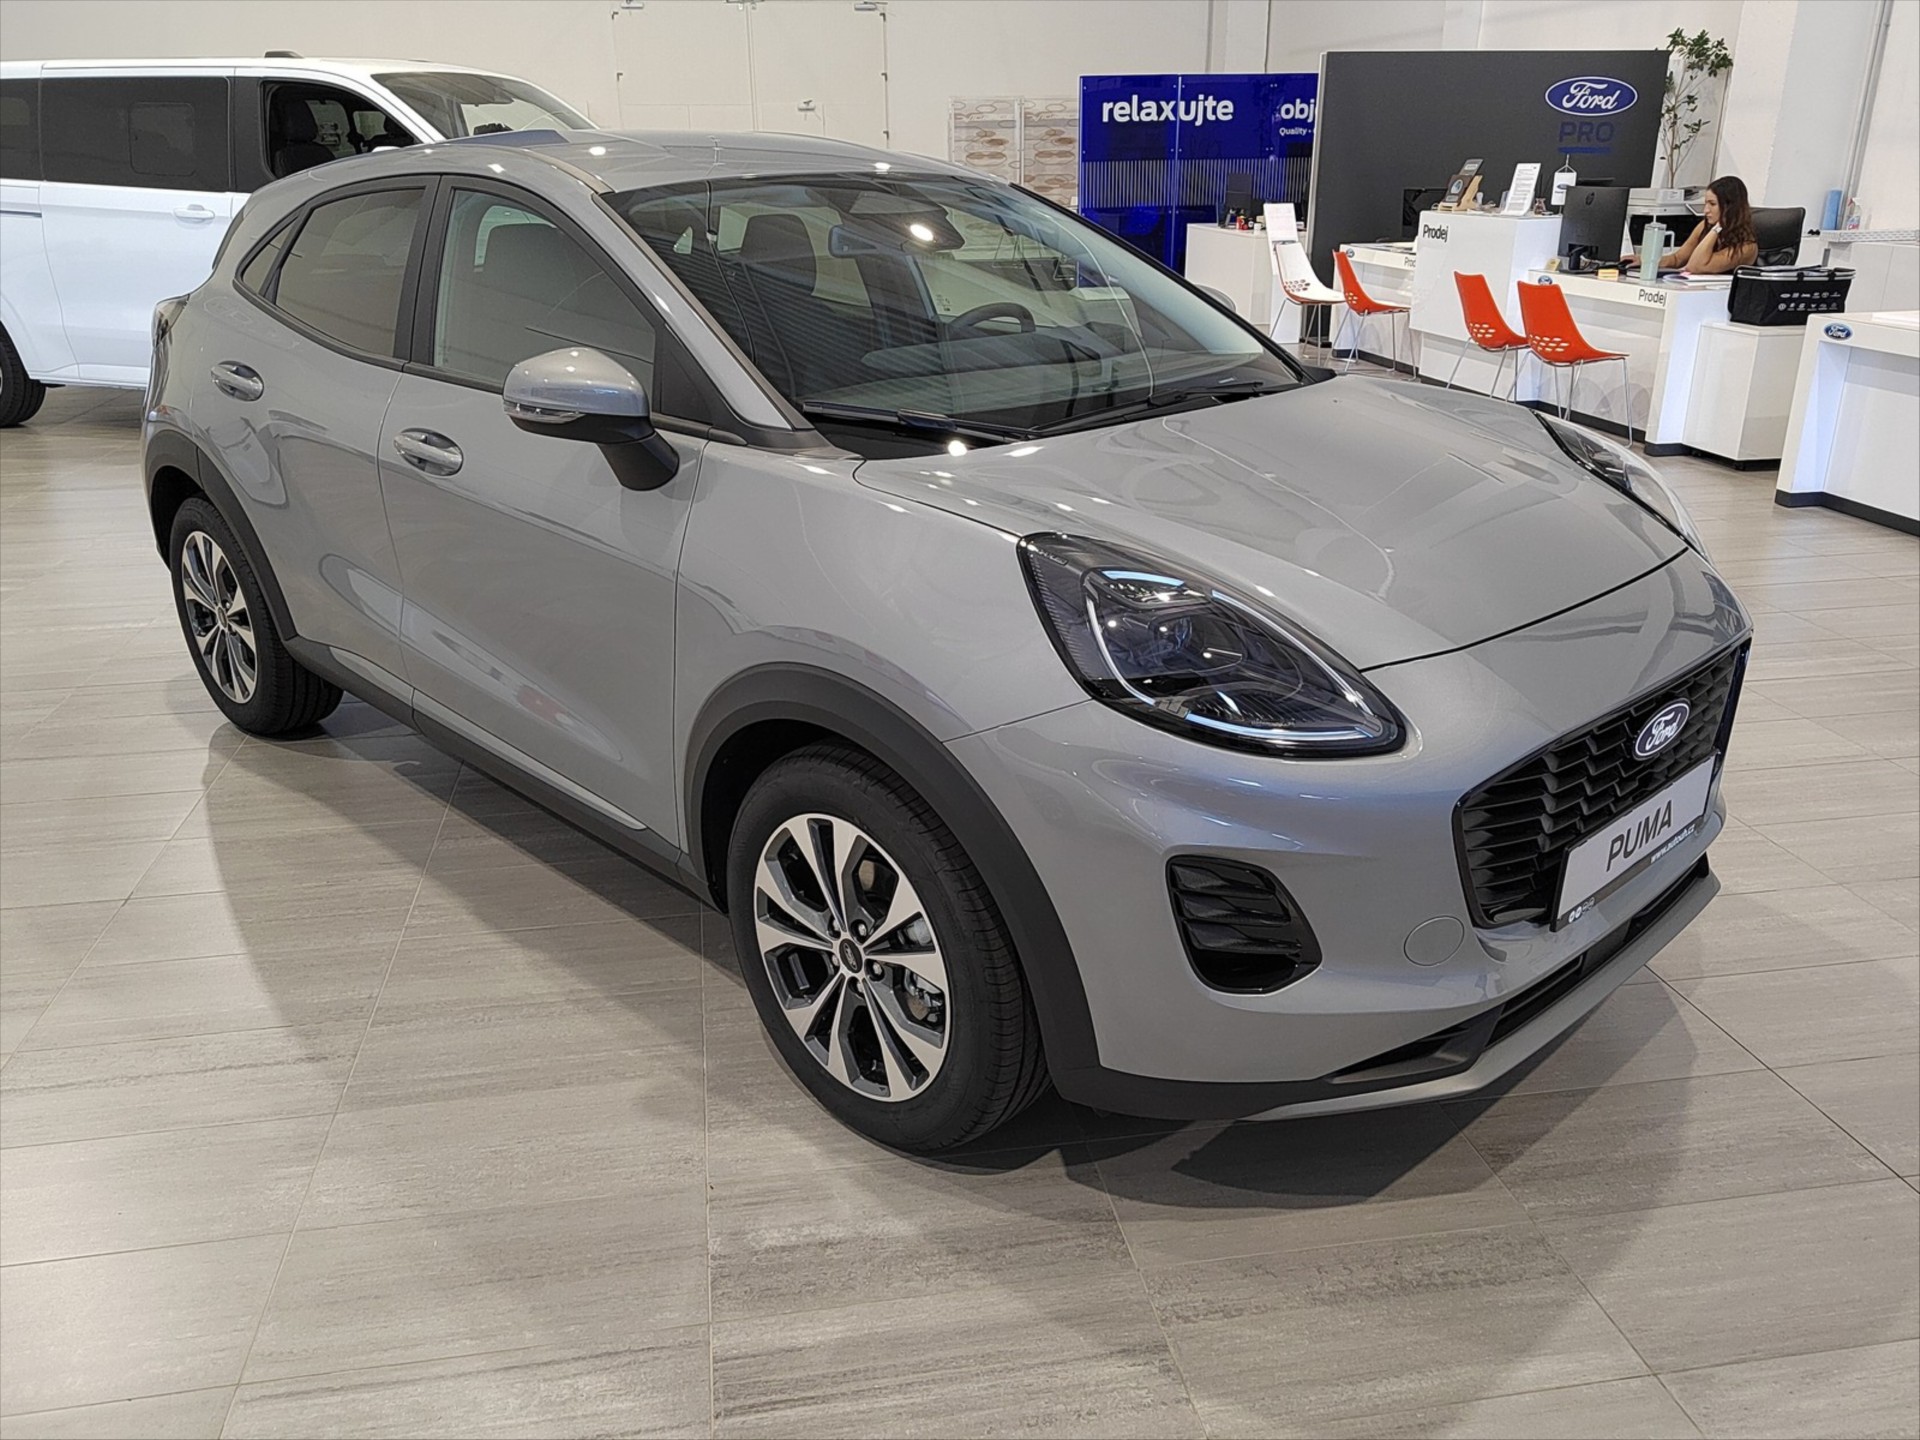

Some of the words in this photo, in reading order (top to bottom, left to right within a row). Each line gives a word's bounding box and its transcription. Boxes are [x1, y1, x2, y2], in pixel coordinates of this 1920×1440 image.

[1562, 81, 1621, 110] Ford
[1102, 94, 1234, 126] relaxujte
[1280, 98, 1315, 123] obj
[1279, 127, 1307, 136] Quality
[1559, 121, 1614, 142] PRO
[1422, 224, 1449, 243] Prodej
[1638, 288, 1667, 307] Prodej
[1645, 711, 1682, 750] Ford
[1606, 799, 1672, 872] PUMA
